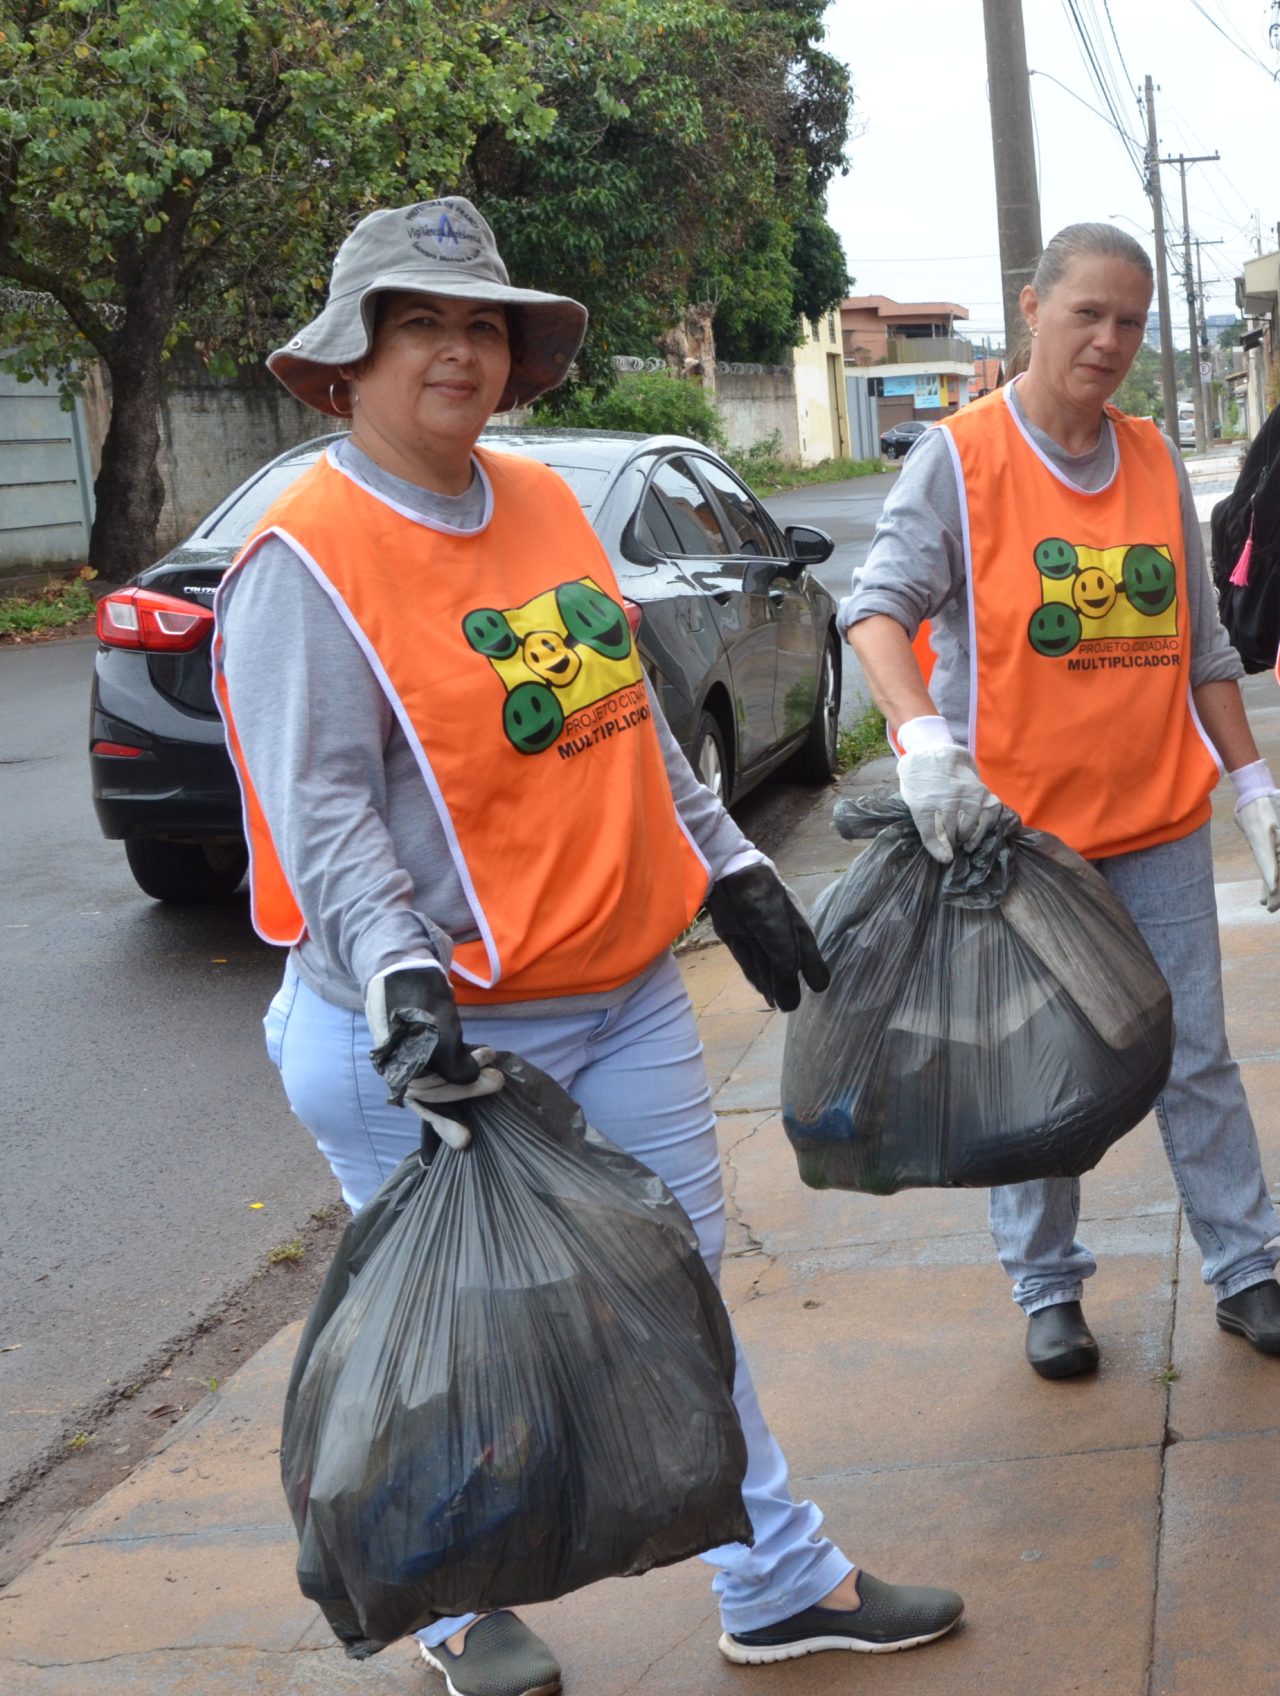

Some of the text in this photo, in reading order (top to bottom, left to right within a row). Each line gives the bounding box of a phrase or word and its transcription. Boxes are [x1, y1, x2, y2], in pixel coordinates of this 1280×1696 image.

[1079, 638, 1179, 654] PROJETO CIDADÃO
[1068, 654, 1180, 671] MULTIPLICADOR
[566, 700, 617, 736] PROJETO
